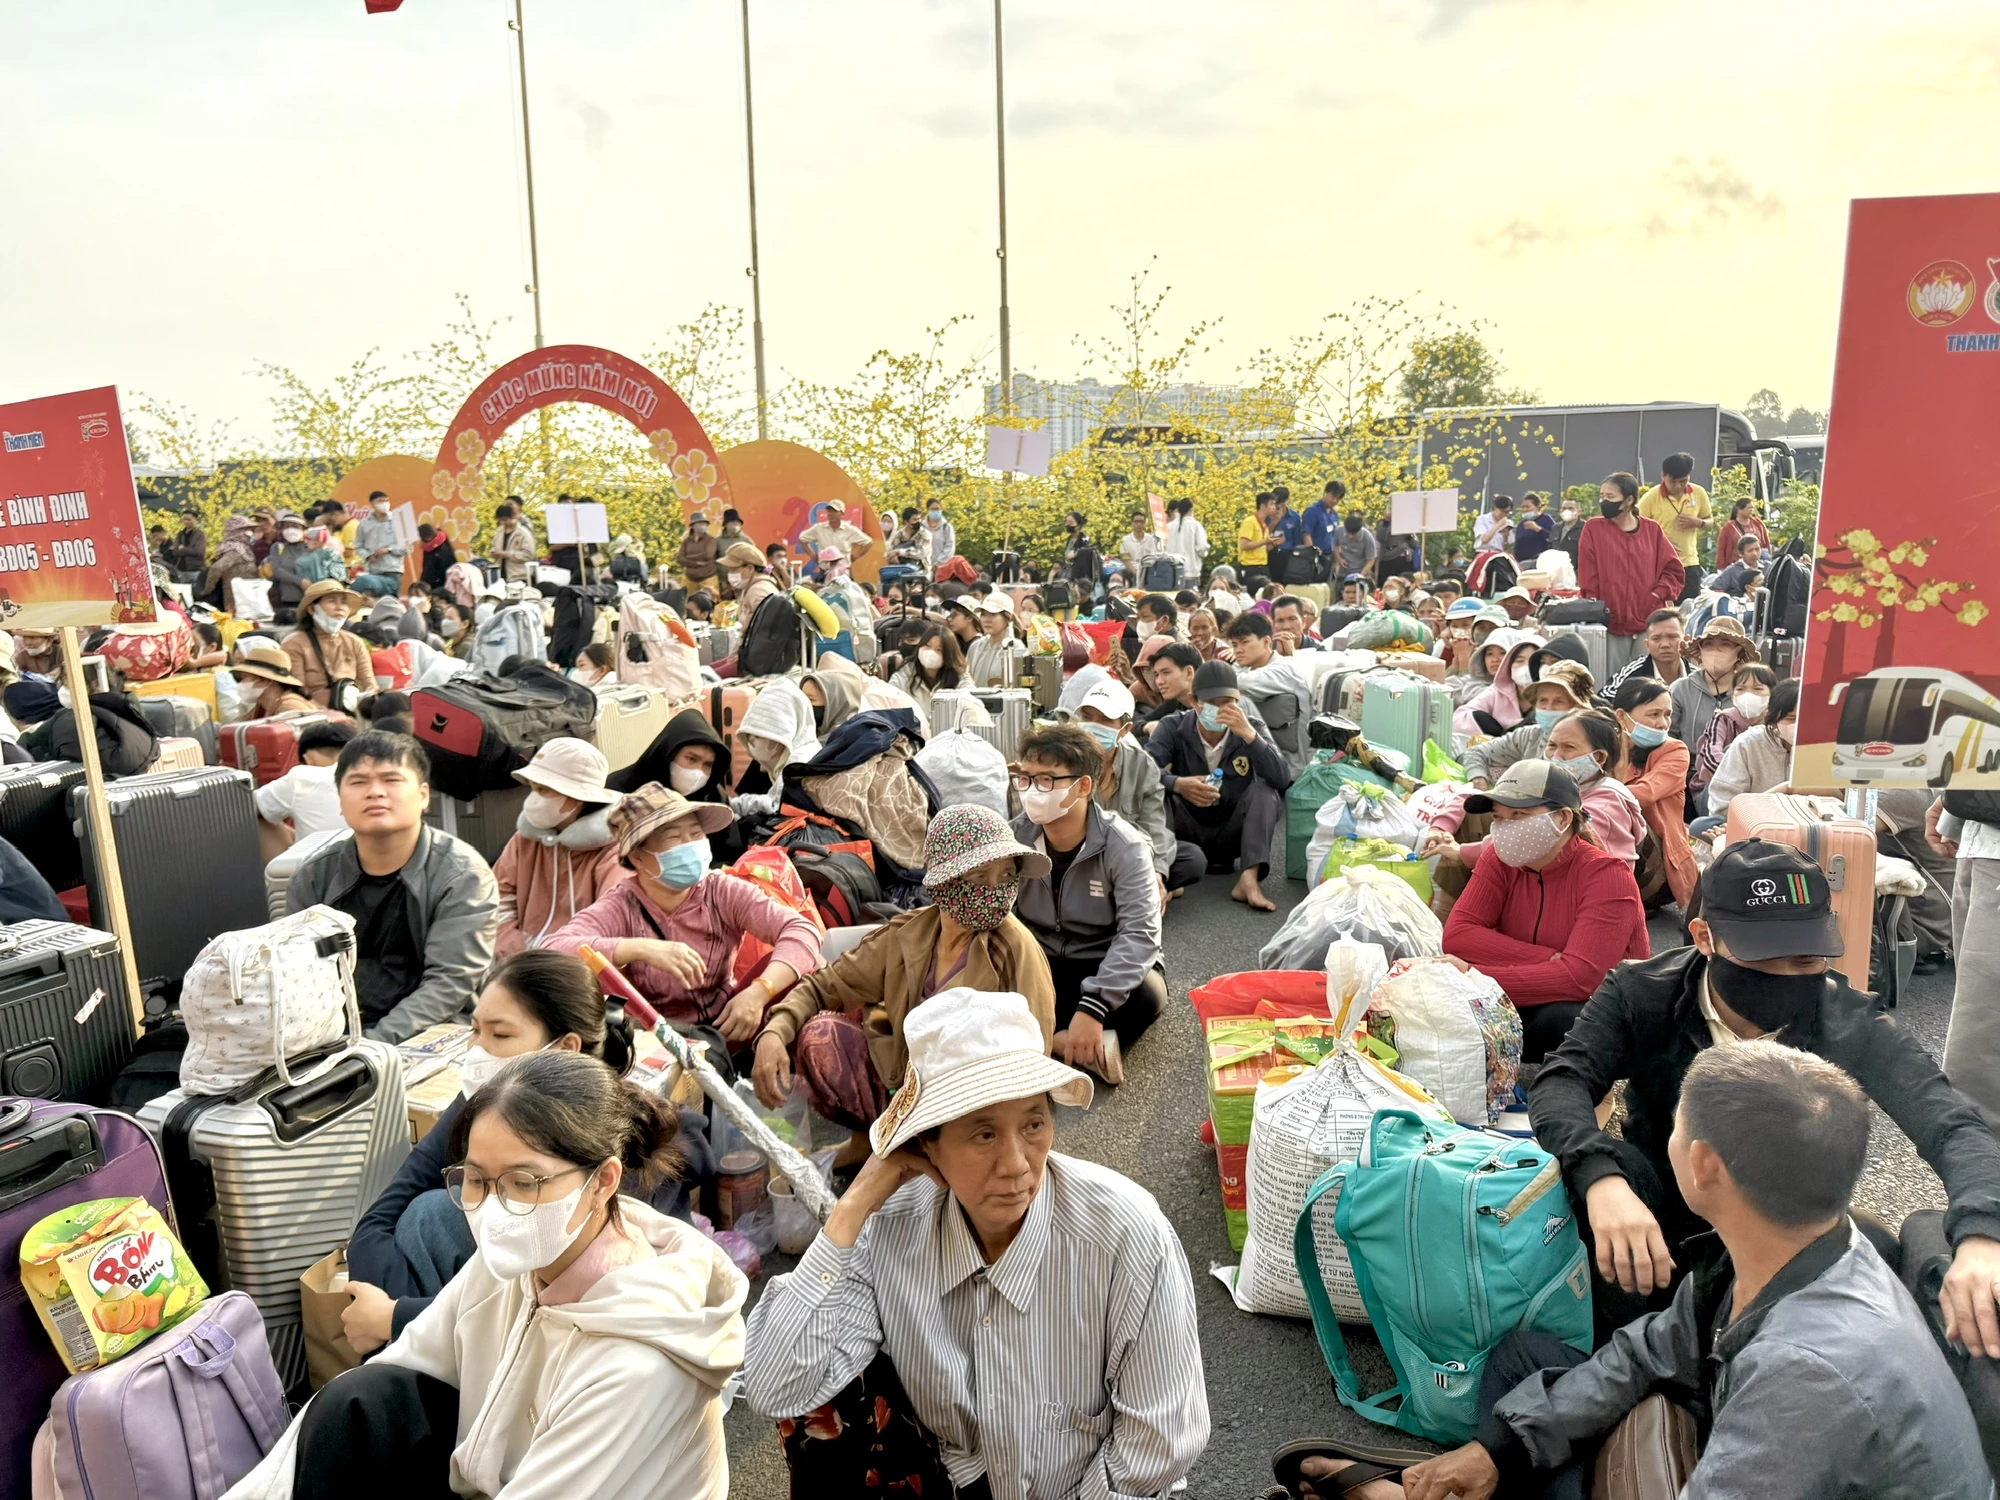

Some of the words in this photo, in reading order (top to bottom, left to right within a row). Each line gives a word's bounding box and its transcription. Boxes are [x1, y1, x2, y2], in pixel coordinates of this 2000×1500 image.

[1947, 331, 2000, 352] THÀNH
[480, 377, 527, 425] CHÚC
[525, 362, 576, 396] MỪNG
[577, 363, 621, 399] NĂM
[617, 377, 660, 420] MỚI
[6, 493, 48, 526] BÌNH
[48, 491, 90, 527] ĐỊNH
[0, 542, 39, 572] BĐ05
[51, 537, 97, 568] BĐ06
[1746, 895, 1787, 907] GUCCI
[1278, 1175, 1305, 1190] NGUYÊN
